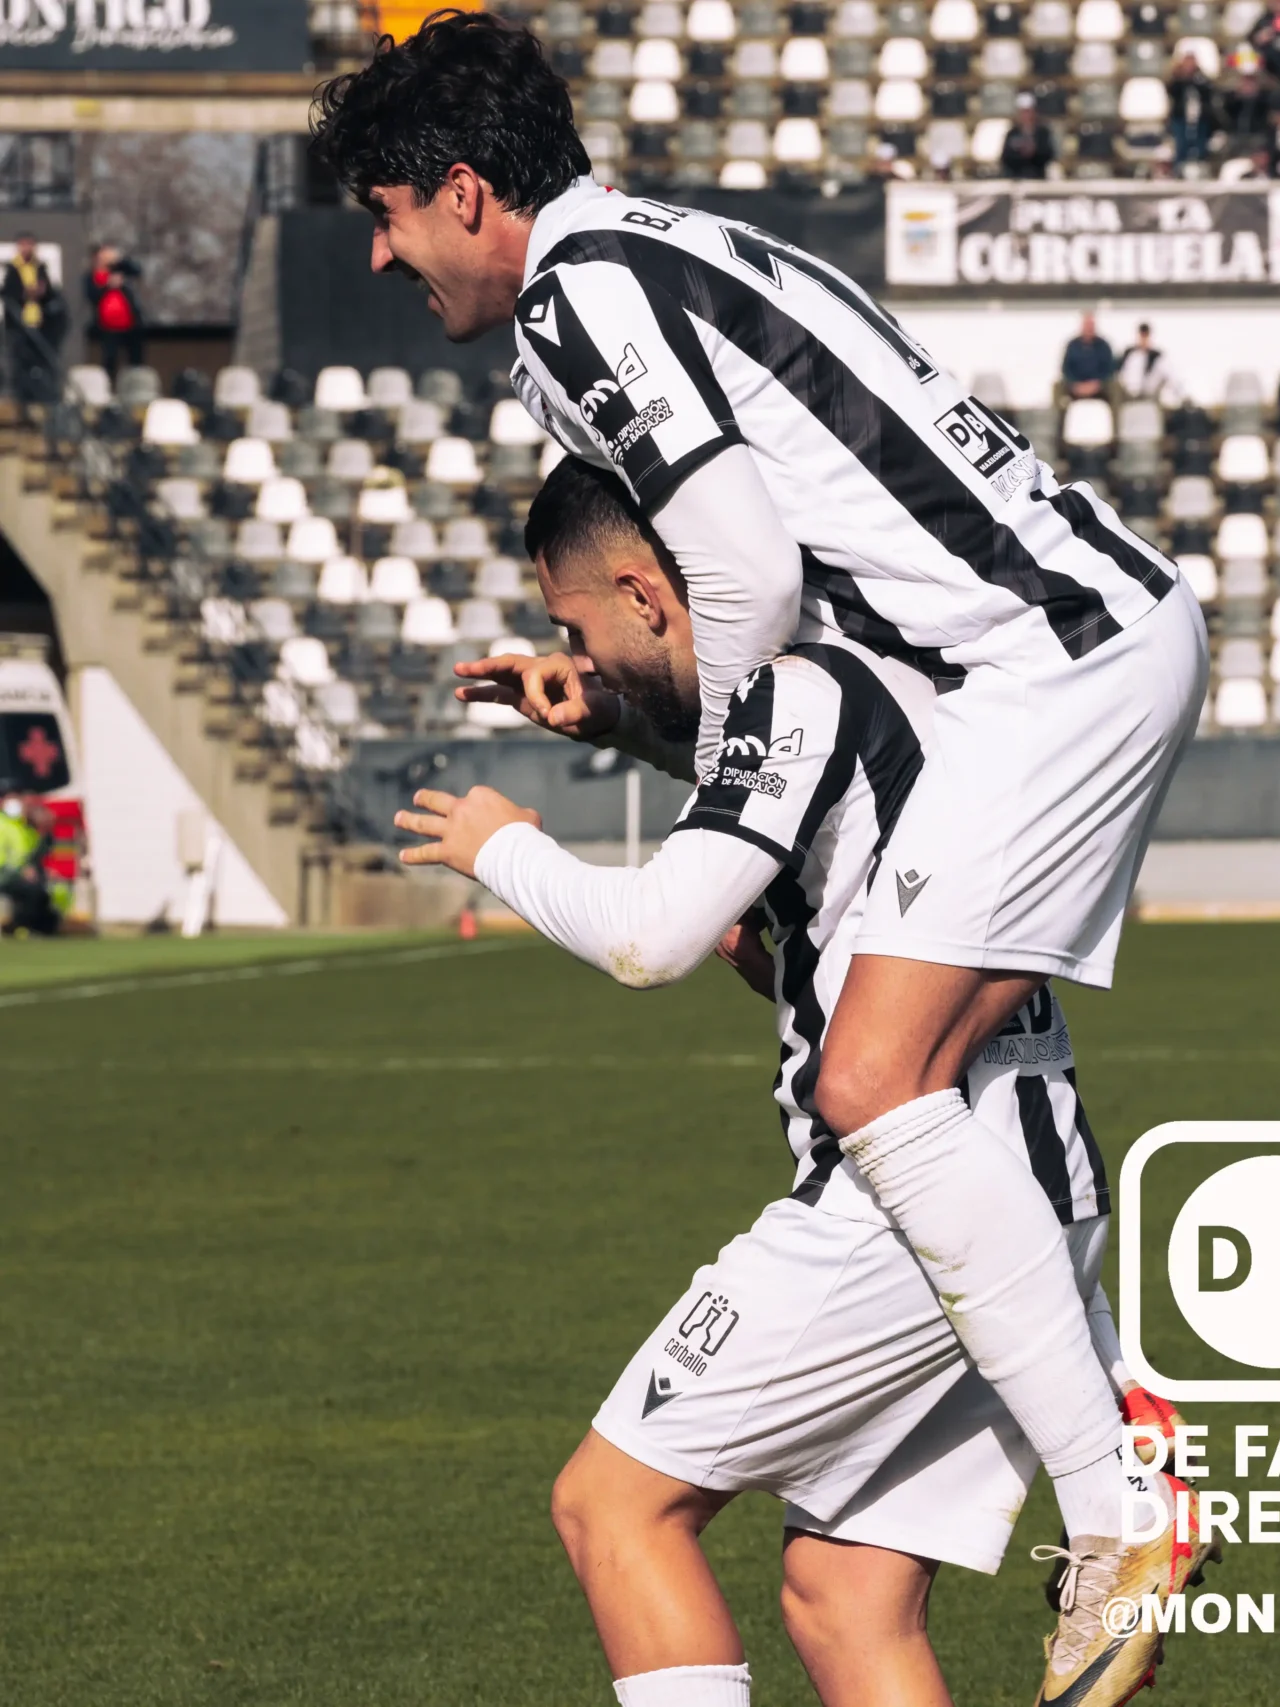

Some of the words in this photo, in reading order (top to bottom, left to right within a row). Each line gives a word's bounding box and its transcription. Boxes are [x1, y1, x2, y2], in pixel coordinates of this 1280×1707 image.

[617, 397, 669, 442] DIPUTACIÓN
[629, 407, 673, 440] BADAJOZ
[721, 778, 732, 786] DE
[733, 778, 783, 799] BADAJOZ
[723, 766, 786, 789] DIPUTACIÓN
[664, 1337, 708, 1377] carballo
